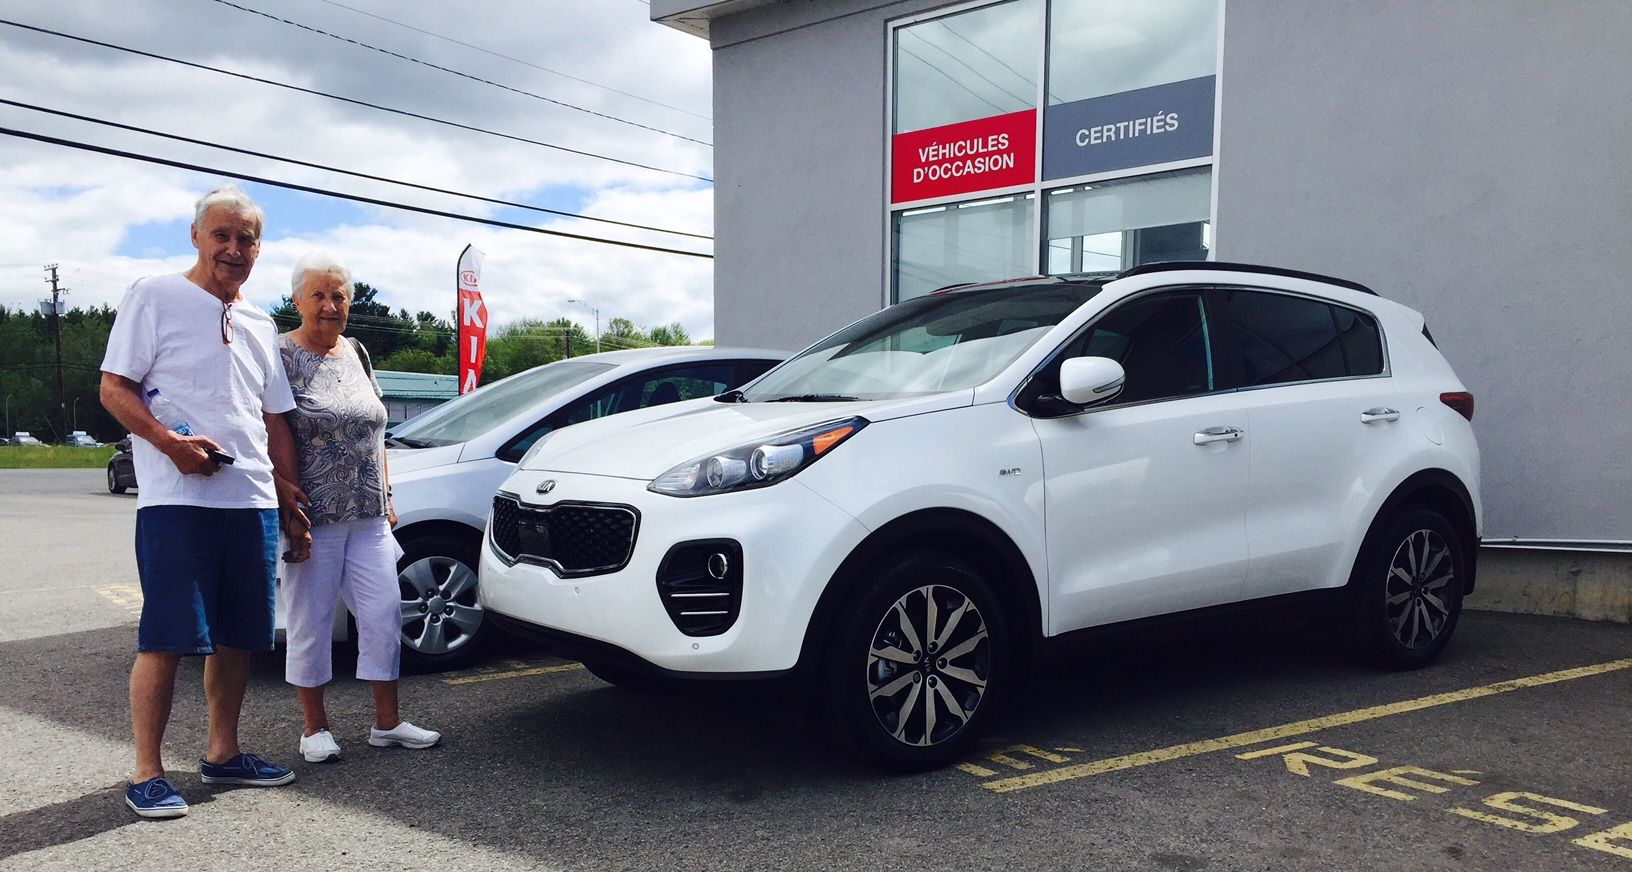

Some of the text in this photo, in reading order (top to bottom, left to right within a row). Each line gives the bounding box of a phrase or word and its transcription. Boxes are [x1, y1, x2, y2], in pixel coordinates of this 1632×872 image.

[1075, 110, 1180, 147] CERTIFIÉS
[918, 133, 1010, 163] VÉHICULES
[913, 152, 1015, 184] D'OCCASION
[462, 297, 485, 395] KIA
